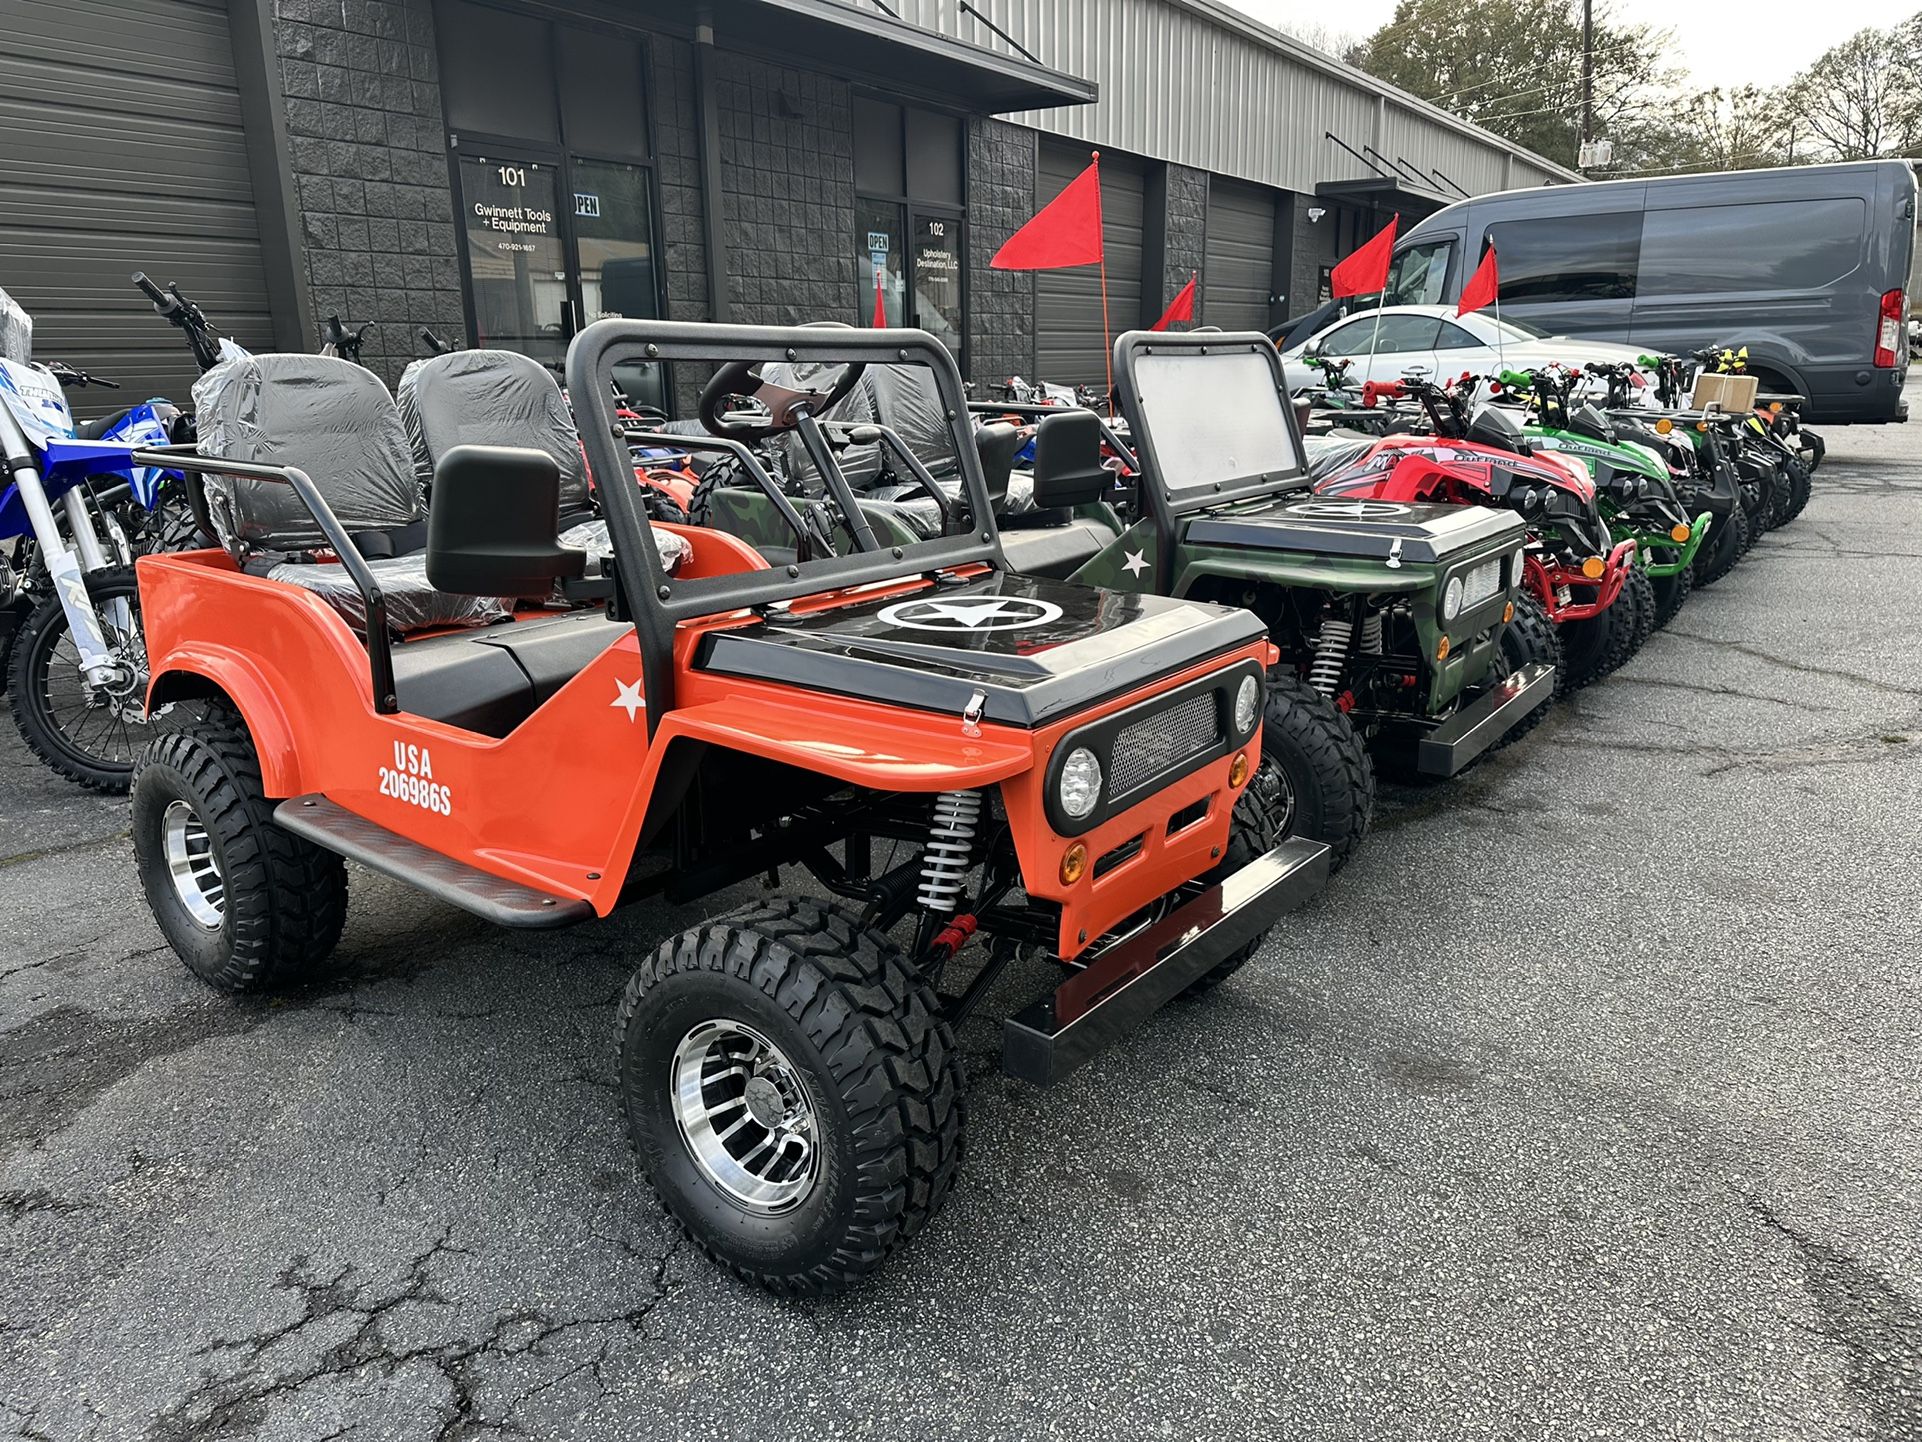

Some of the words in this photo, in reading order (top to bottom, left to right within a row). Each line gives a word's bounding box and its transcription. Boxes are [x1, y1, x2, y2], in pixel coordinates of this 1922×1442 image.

[498, 166, 526, 187] 101
[474, 203, 523, 219] Gwinnett
[524, 207, 552, 222] Tools
[576, 195, 598, 215] PEN
[482, 218, 490, 227] +
[491, 217, 547, 234] Equipment
[929, 221, 944, 236] 102
[869, 234, 888, 249] OPEN
[923, 248, 952, 260] Upholstery
[1454, 454, 1517, 467] Outland
[393, 740, 433, 780] USA
[379, 766, 452, 816] 206986S
